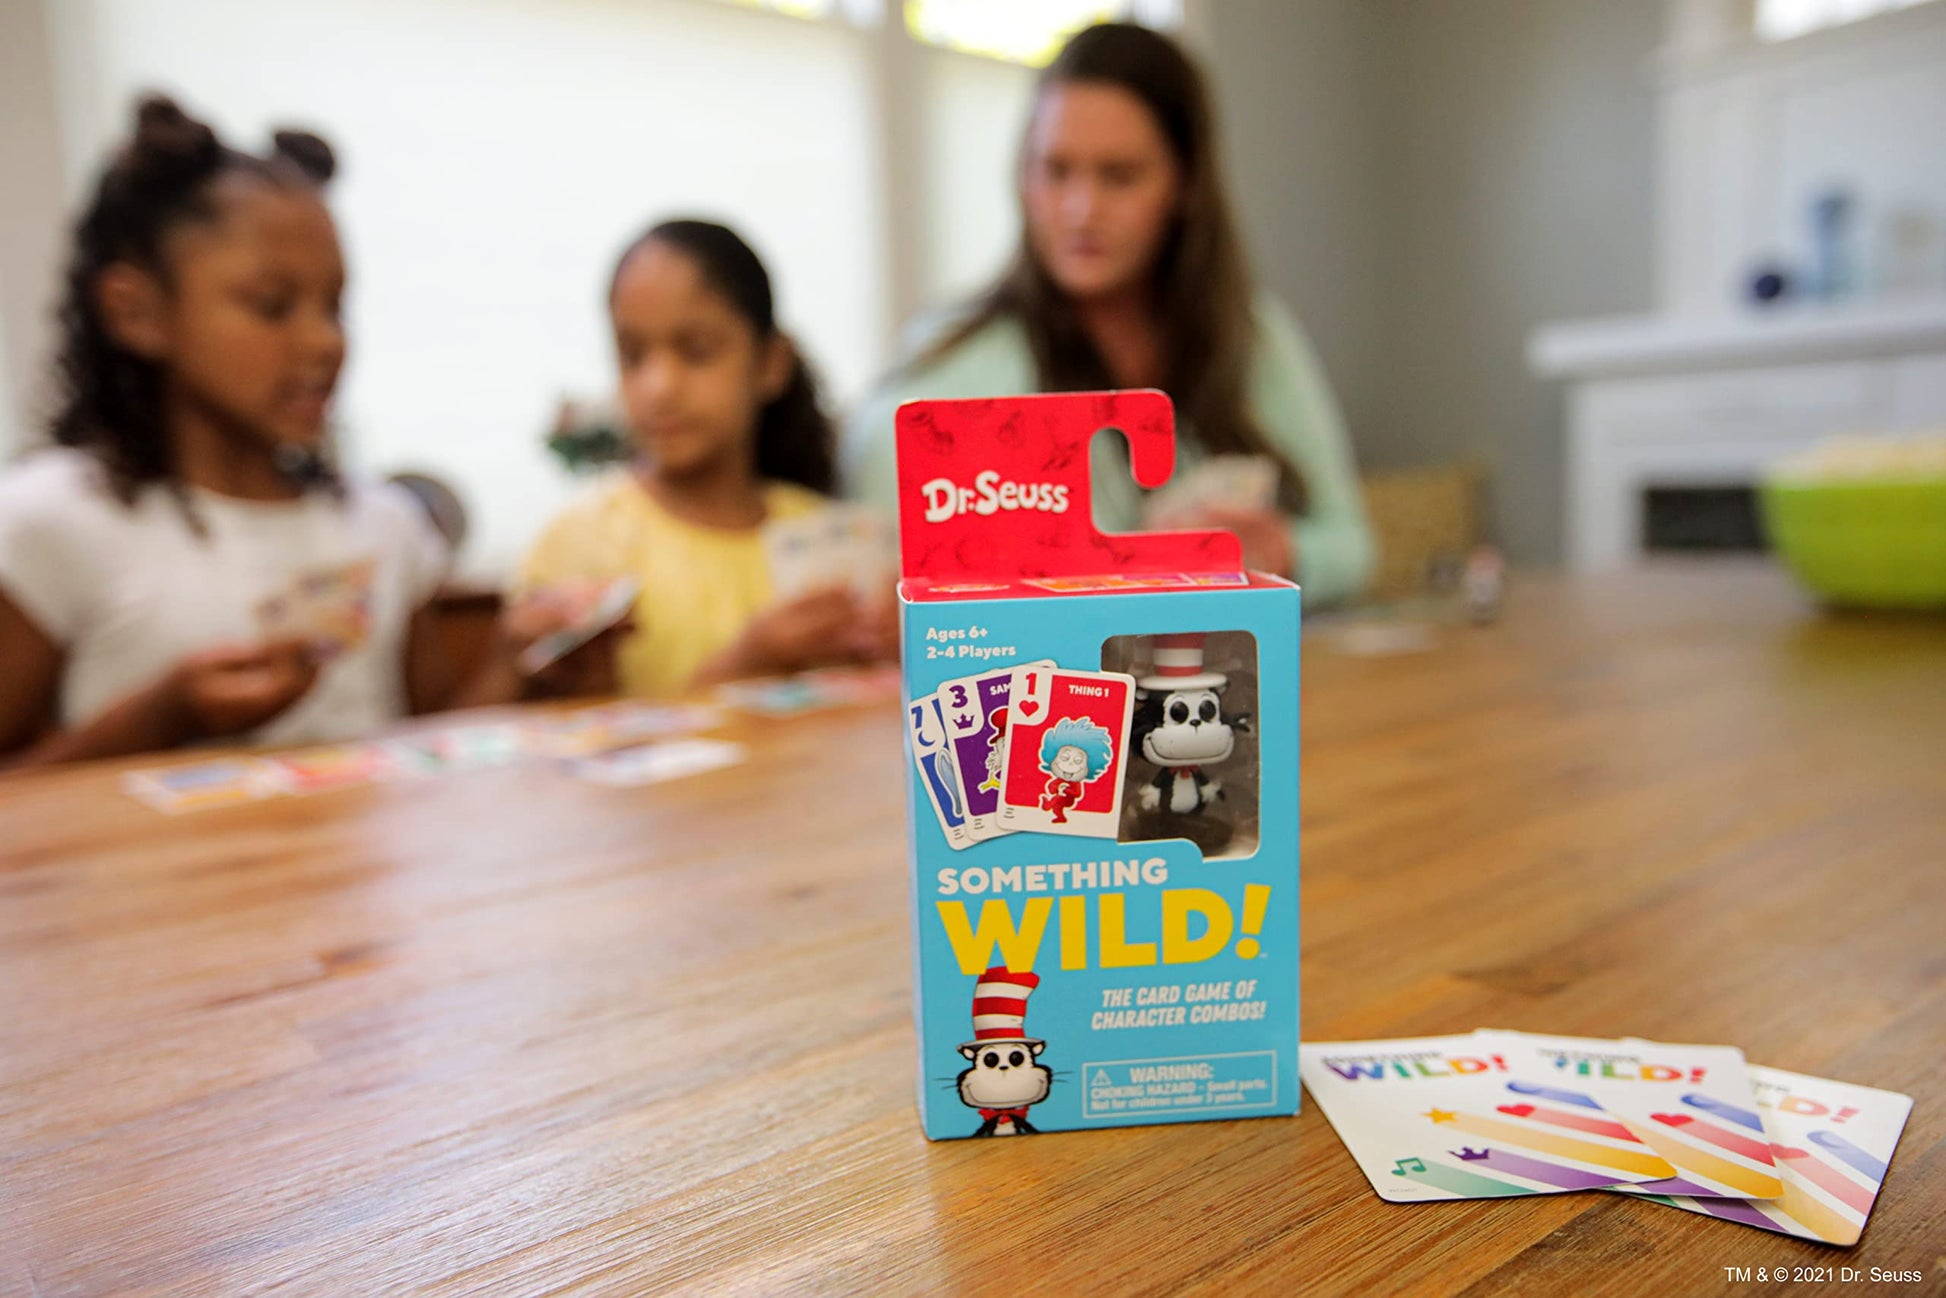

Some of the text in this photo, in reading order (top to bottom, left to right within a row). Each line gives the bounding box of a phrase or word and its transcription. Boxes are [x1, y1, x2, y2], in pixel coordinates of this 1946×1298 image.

[926, 626, 988, 643] Ages 6+
[927, 644, 1016, 660] 2-4 Players
[1026, 672, 1037, 695] 1
[1069, 685, 1110, 697] THING 1
[949, 685, 968, 708] 3
[937, 857, 1168, 895] SOMETHING
[935, 883, 1272, 975] WILD!
[1102, 979, 1258, 1008] THE CARD GAME OF
[1091, 1001, 1267, 1030] CHARACTER COMBOS!
[1130, 1062, 1214, 1083] WARNING:
[1326, 1053, 1509, 1080] WILD!
[1555, 1057, 1707, 1084] ILD!
